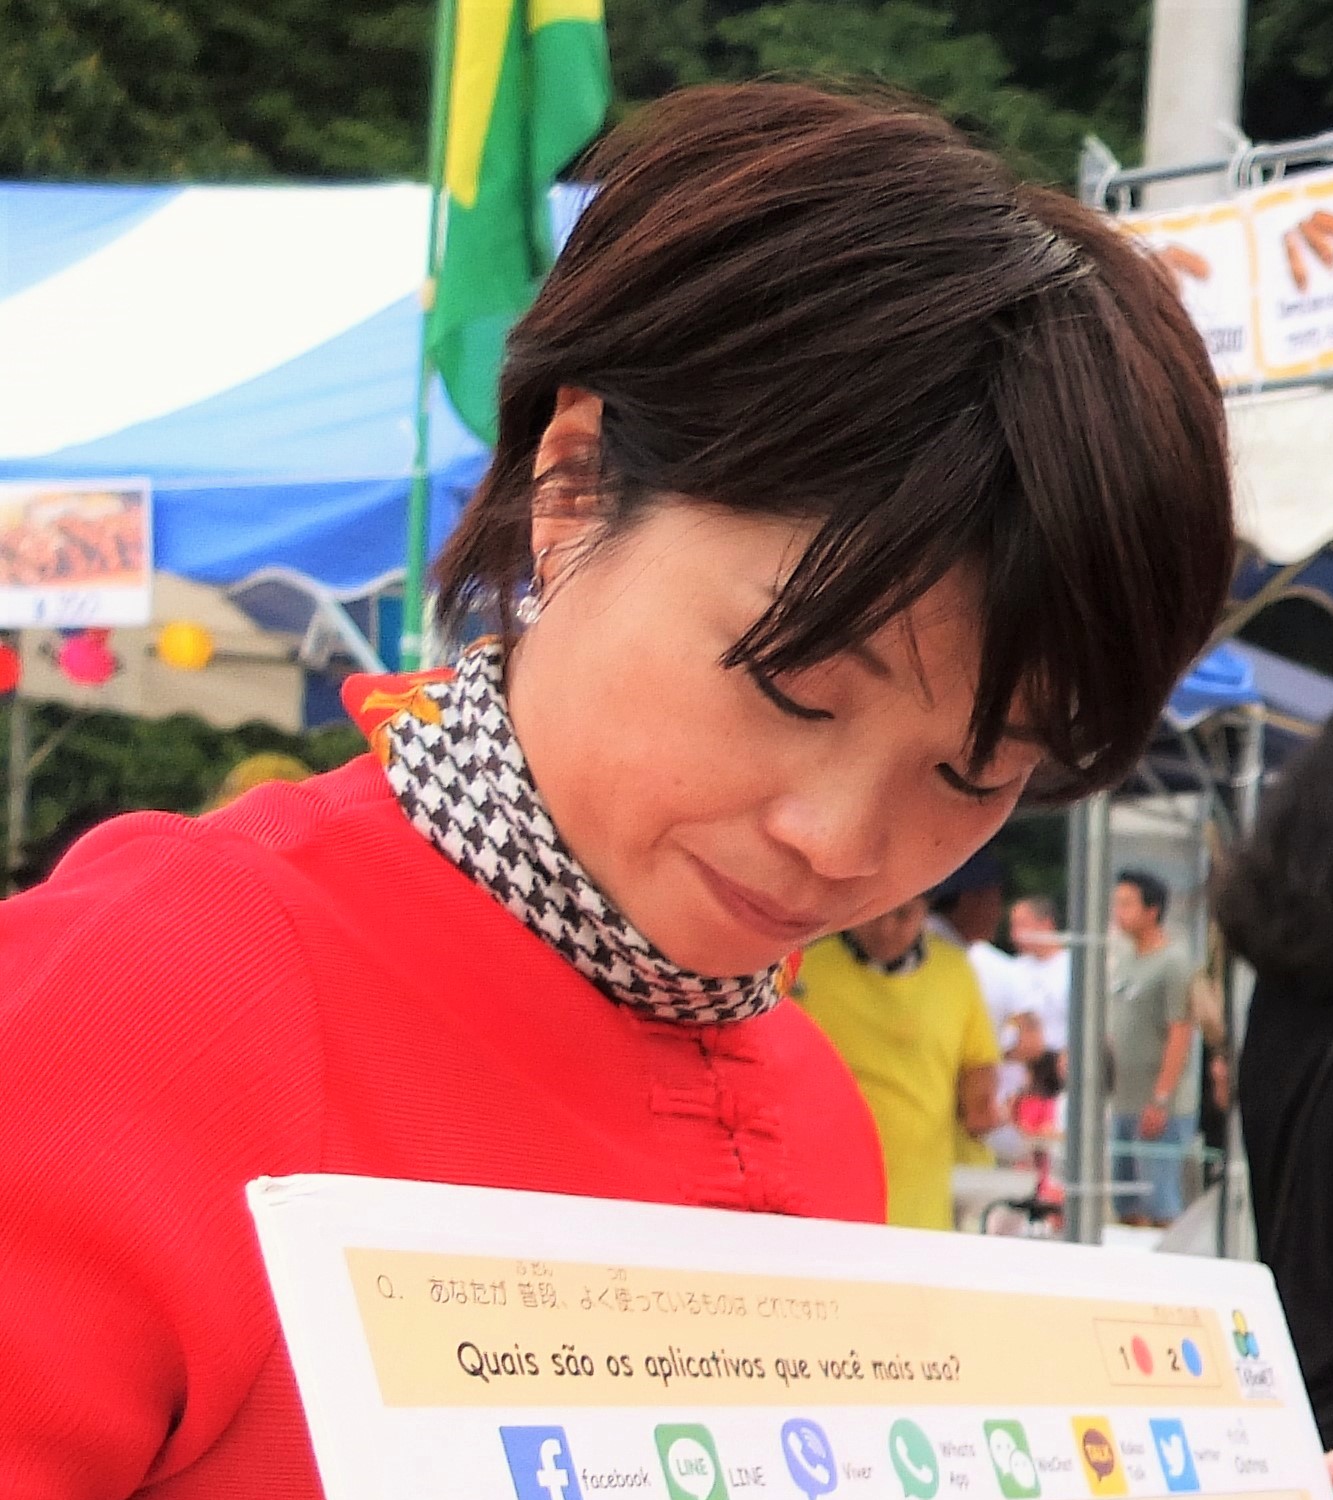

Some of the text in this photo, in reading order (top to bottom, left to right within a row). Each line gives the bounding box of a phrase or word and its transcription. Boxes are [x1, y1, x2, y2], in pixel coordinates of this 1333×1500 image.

[457, 1340, 961, 1388] Quais são os aplicativos que você mais usa?
[1166, 1347, 1181, 1372] 2
[580, 1466, 652, 1491] facebook
[675, 1457, 709, 1478] LINE
[729, 1465, 768, 1488] LINE
